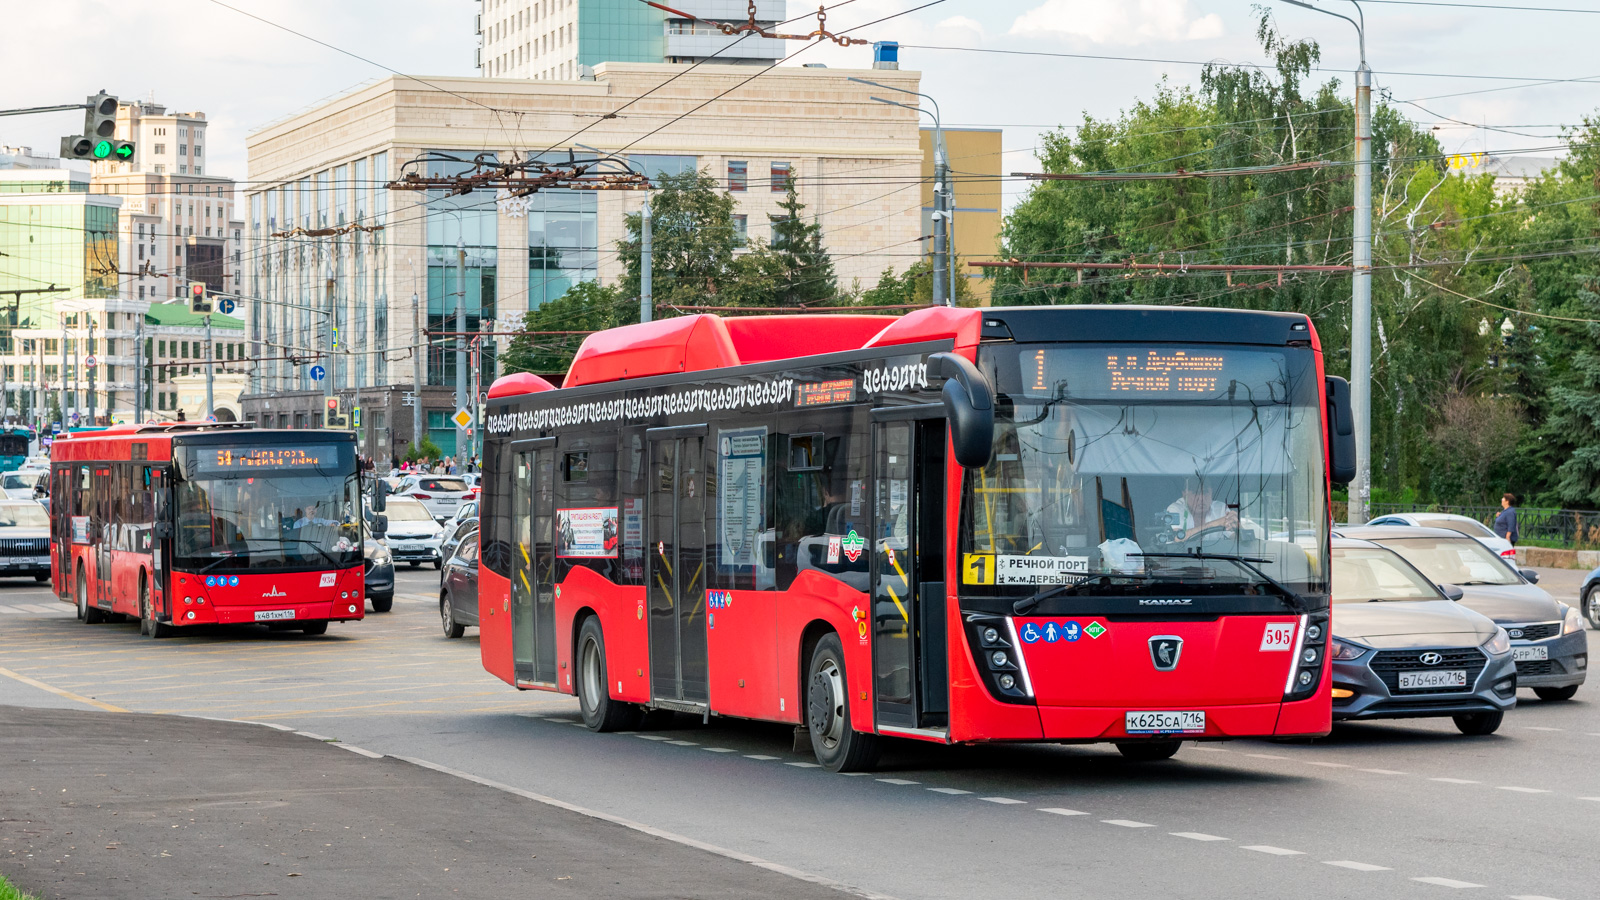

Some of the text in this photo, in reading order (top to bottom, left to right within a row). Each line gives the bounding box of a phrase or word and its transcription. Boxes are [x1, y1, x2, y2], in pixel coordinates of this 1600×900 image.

[1032, 350, 1047, 389] 1
[829, 542, 839, 557] 595
[971, 557, 986, 583] 1
[1009, 558, 1087, 570] РЕЧНОЙ ПОРТ
[321, 575, 335, 585] 936
[1266, 629, 1290, 645] 595
[1532, 647, 1546, 656] 716
[1403, 672, 1463, 687] В764ВК 716
[1131, 713, 1201, 728] К625СА 716
